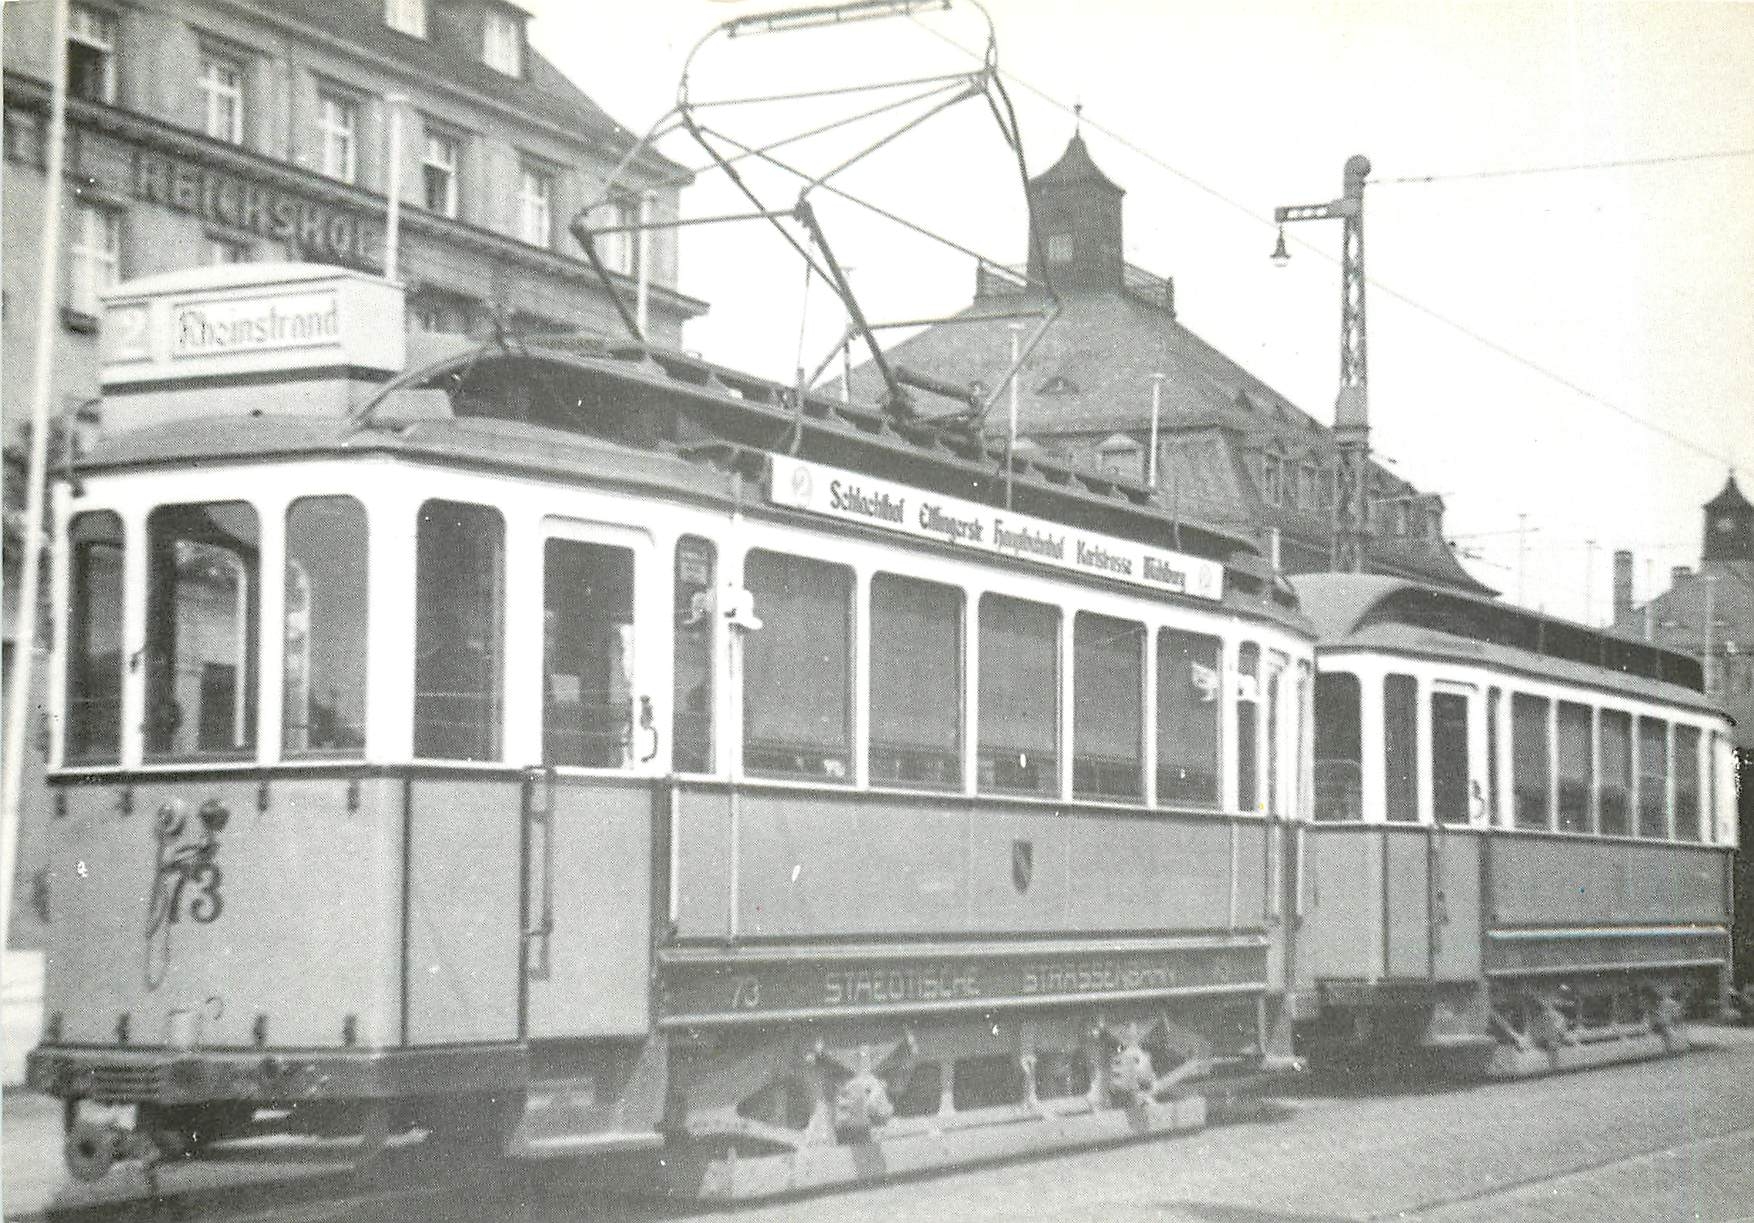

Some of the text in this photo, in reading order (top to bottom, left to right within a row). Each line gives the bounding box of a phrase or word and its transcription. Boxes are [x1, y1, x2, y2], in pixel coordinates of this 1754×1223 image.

[178, 300, 338, 347] Rheinstrand
[829, 479, 905, 523] Schlachthof
[160, 861, 224, 924] 73
[731, 974, 761, 1009] 73
